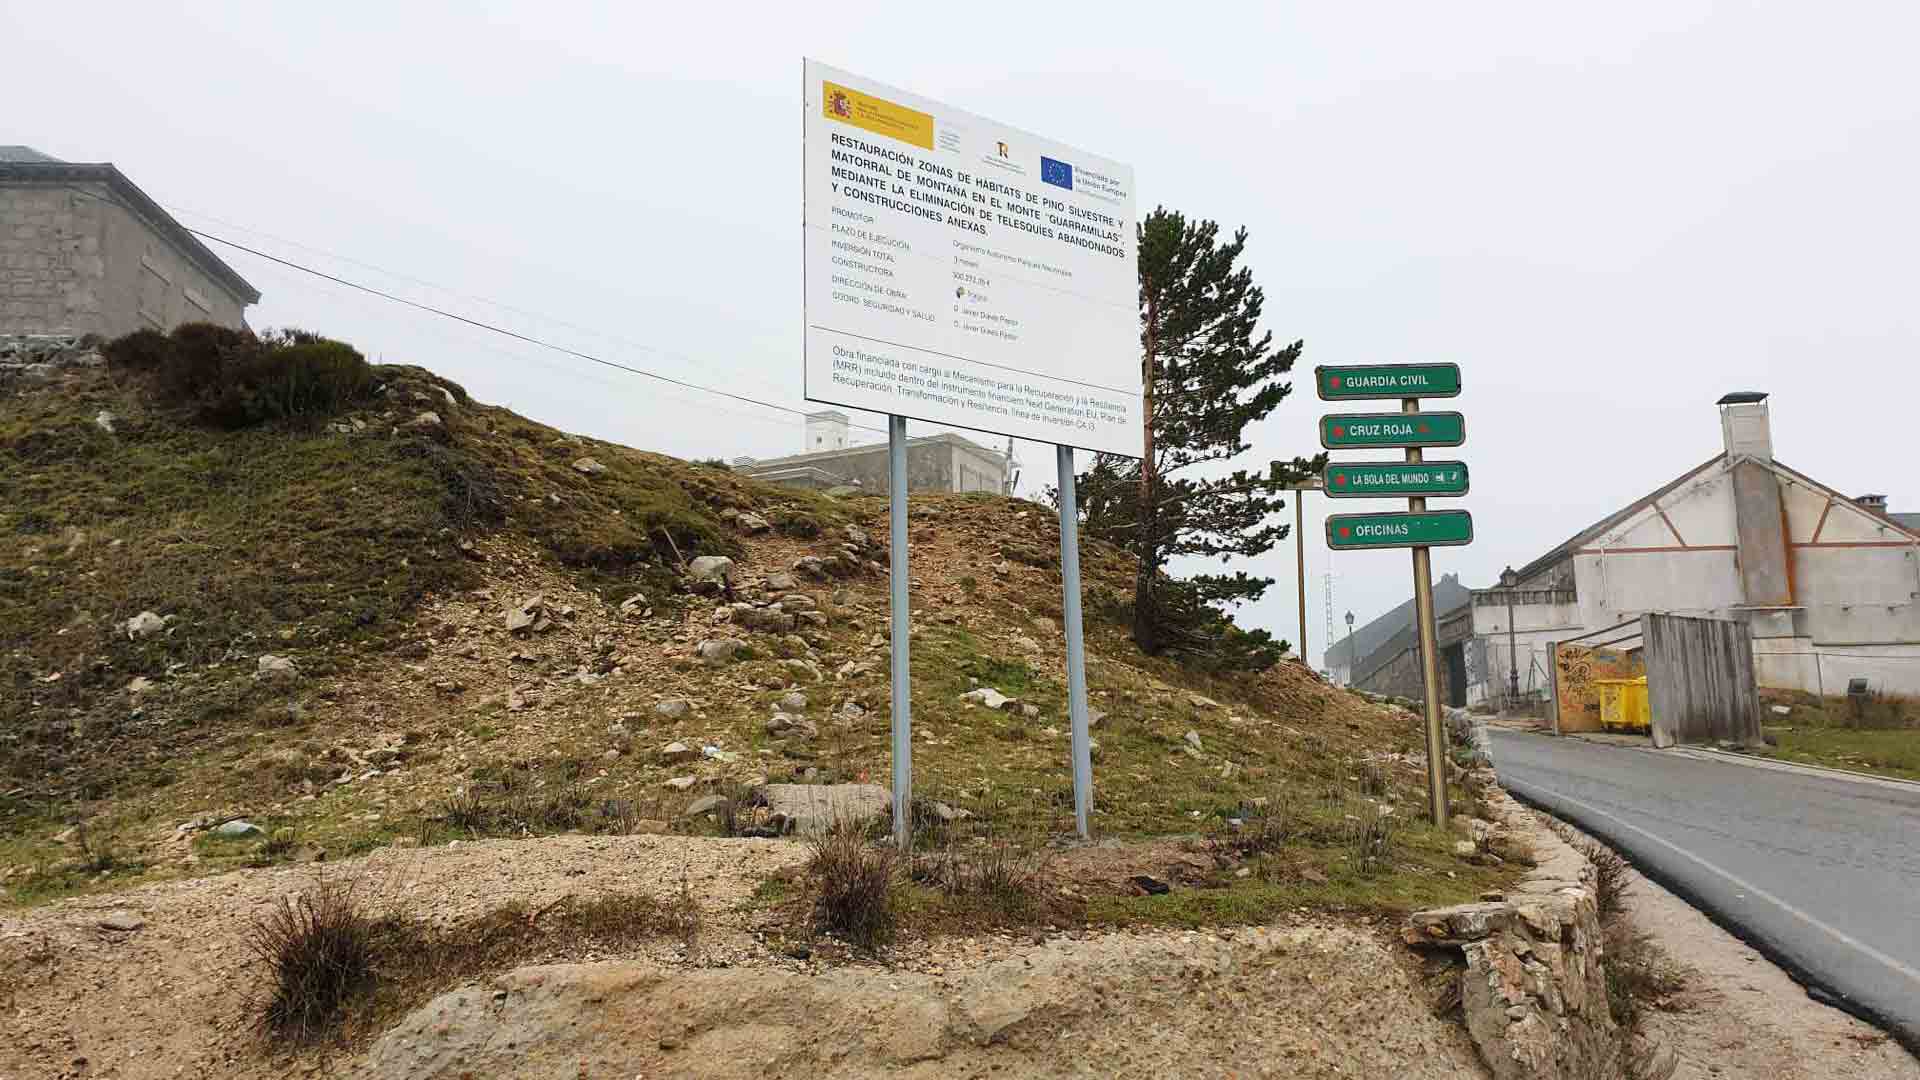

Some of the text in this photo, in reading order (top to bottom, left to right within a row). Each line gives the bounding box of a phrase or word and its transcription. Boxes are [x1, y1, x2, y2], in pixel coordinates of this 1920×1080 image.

[831, 130, 913, 167] RESTAURACIÓN
[918, 159, 952, 179] ZONAS
[958, 171, 971, 185] DE
[1025, 192, 1038, 204] DE
[1042, 197, 1064, 212] PINO
[1068, 204, 1115, 227] SILVESTRE
[1118, 219, 1123, 229] Y
[831, 149, 892, 176] MATORRAL
[896, 168, 911, 182] DE
[972, 190, 985, 204] EN
[990, 196, 1002, 209] EL
[1007, 201, 1040, 220] MONTE
[831, 181, 838, 193] Y
[843, 185, 942, 223] CONSTRUCCIONES
[831, 165, 886, 191] MEDIANTE
[891, 182, 904, 196] LA
[910, 186, 974, 216] ELIMINACIÓN
[979, 208, 992, 222] DE
[1057, 230, 1124, 259] ABANDONADOS
[831, 221, 856, 238] PLAZO
[857, 229, 867, 240] DE
[831, 237, 871, 257] INVERSIÓN
[831, 272, 872, 292] DIRECCIÓN
[873, 283, 884, 295] DE
[863, 297, 904, 316] SEGURIDAD
[832, 343, 854, 360] Obra
[855, 348, 899, 369] financiada
[901, 360, 916, 372] con
[919, 363, 941, 379] cargo
[952, 369, 995, 388] Mecanismo
[996, 379, 1013, 394] para
[1023, 384, 1073, 405] Recuperación
[832, 357, 861, 376] (MRR)
[863, 364, 895, 381] incluido
[898, 371, 924, 386] dentro
[927, 377, 938, 389] del
[1025, 397, 1042, 409] Next
[1346, 374, 1429, 388] GUARDIA CIVIL
[896, 384, 958, 407] Transformación
[1350, 423, 1413, 436] CRUZ ROJA
[1352, 473, 1429, 485] LA BOLA DEL MUNDO
[1356, 524, 1409, 537] OFICINAS
